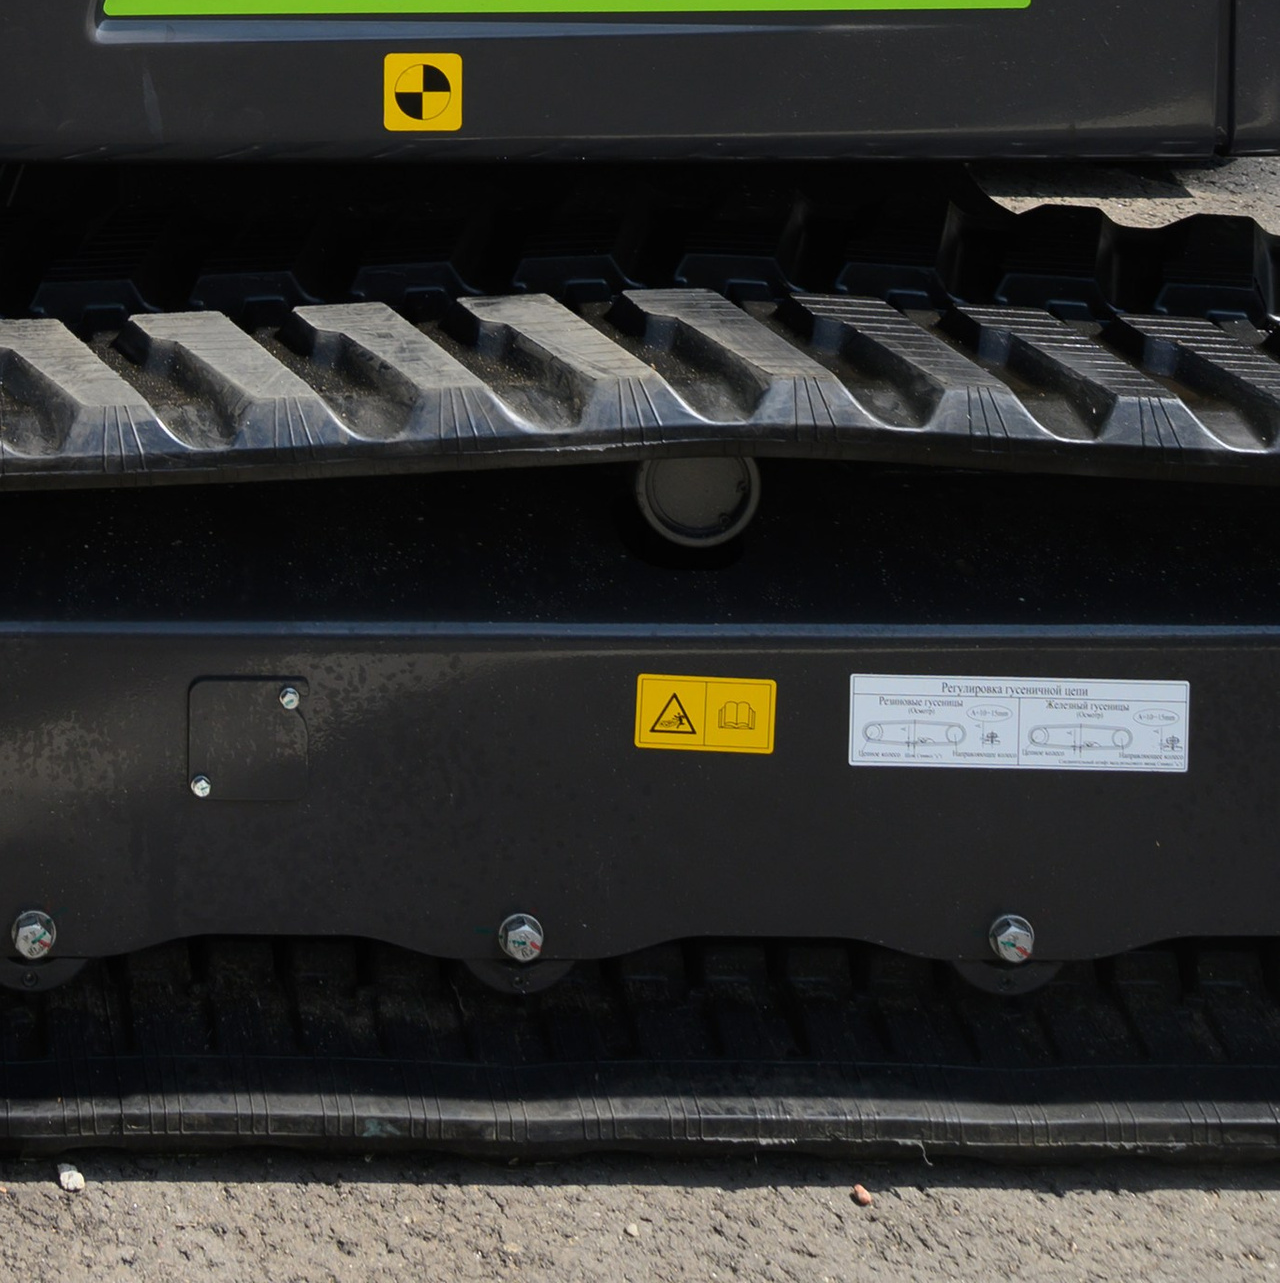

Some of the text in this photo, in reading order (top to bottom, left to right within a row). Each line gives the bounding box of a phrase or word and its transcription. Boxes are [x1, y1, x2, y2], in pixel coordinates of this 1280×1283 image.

[941, 682, 1089, 698] Регулировка гусеничной цепи
[879, 696, 963, 708] Резиновые гусеницы
[1045, 700, 1130, 712] Железный гусеницы
